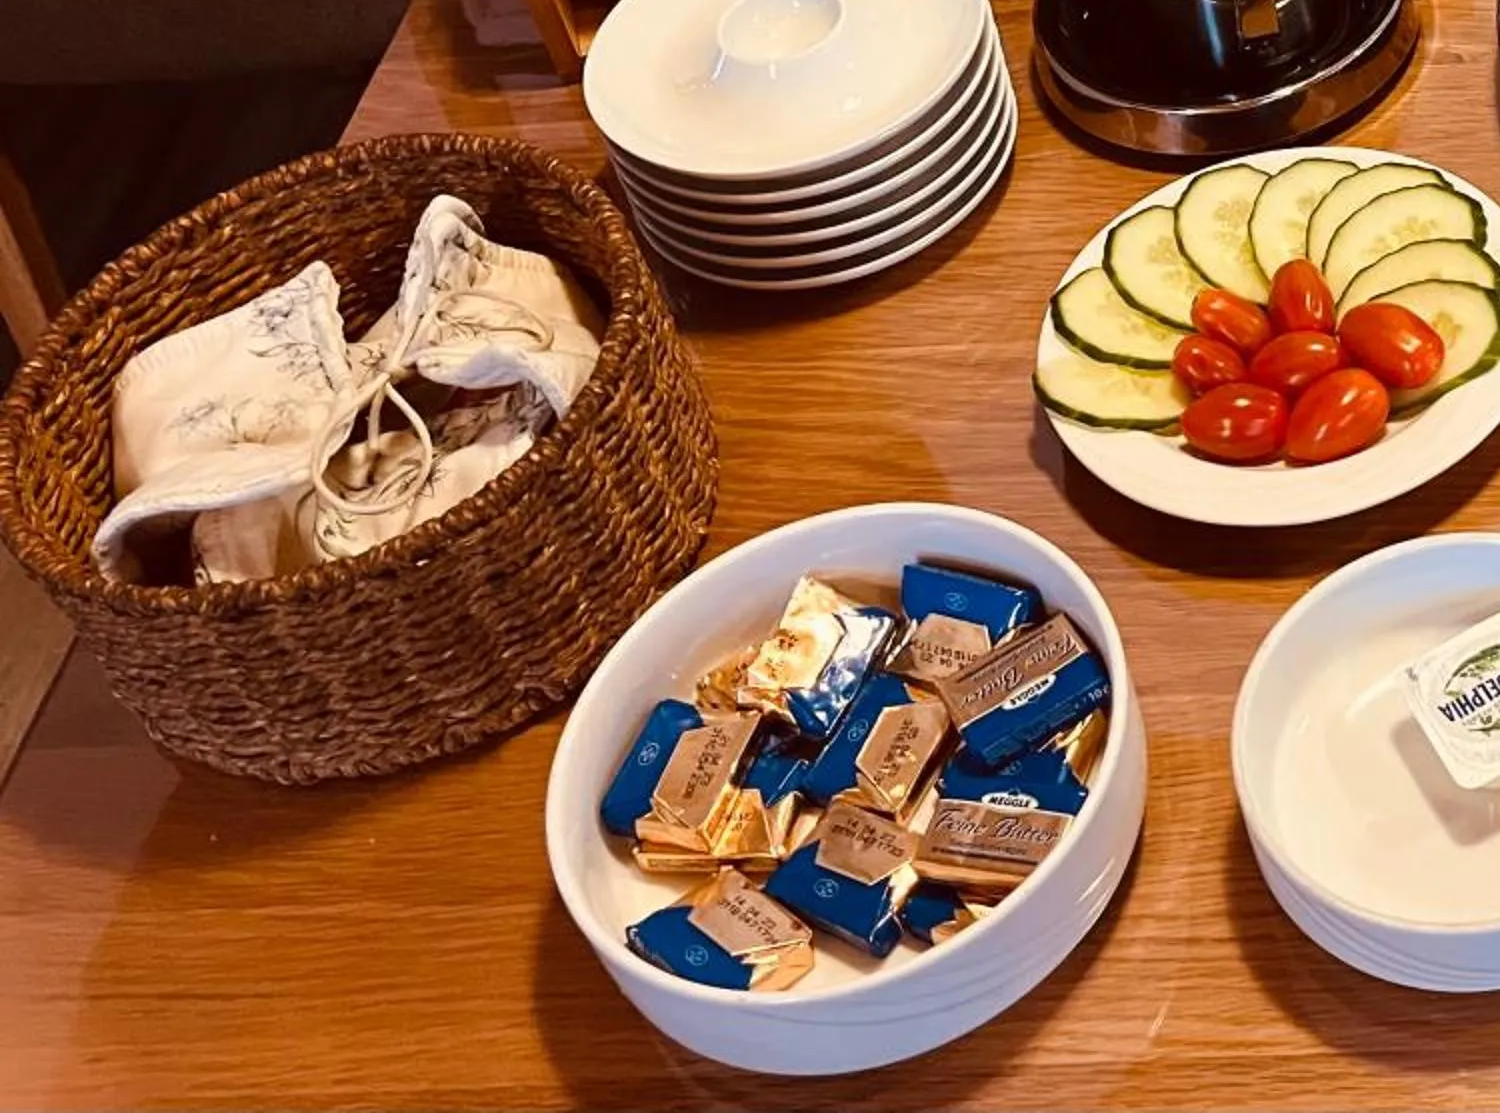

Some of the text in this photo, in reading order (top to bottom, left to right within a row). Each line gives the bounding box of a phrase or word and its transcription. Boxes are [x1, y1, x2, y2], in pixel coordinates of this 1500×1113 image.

[987, 796, 1031, 808] MEGGLE
[935, 807, 1059, 843] Feine Butter
